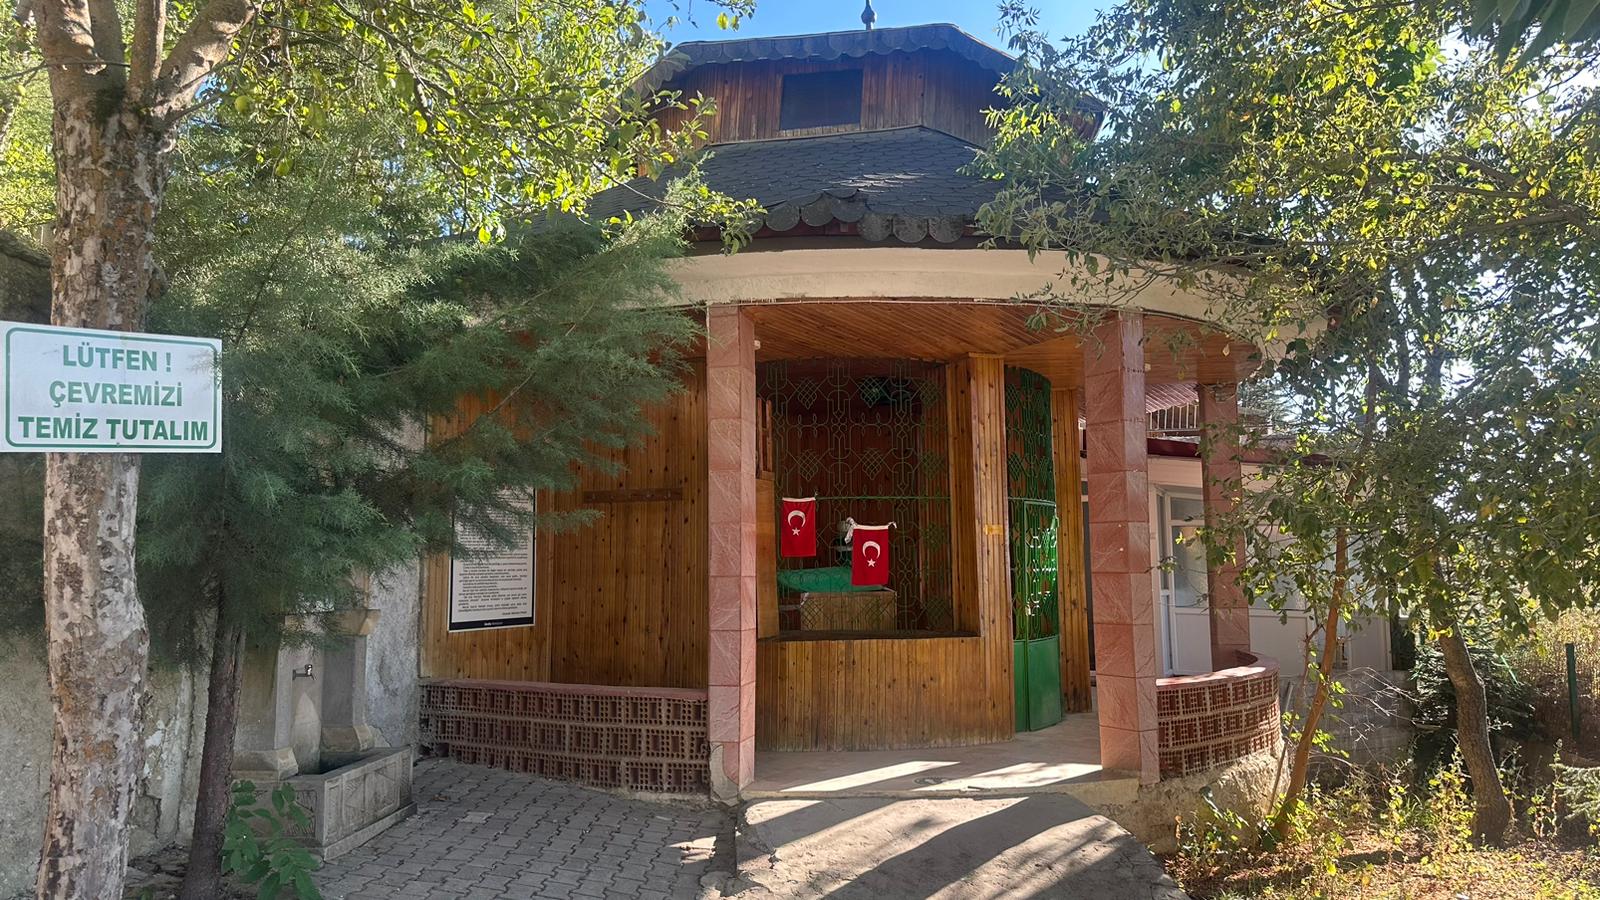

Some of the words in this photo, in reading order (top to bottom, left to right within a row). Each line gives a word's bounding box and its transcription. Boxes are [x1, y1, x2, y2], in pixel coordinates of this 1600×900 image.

[63, 342, 157, 371] LÜTFEN
[165, 352, 172, 372] !
[50, 380, 183, 408] ÇEVREMİZİ
[18, 412, 98, 439] TEMİZ
[106, 418, 208, 441] TUTALIM
